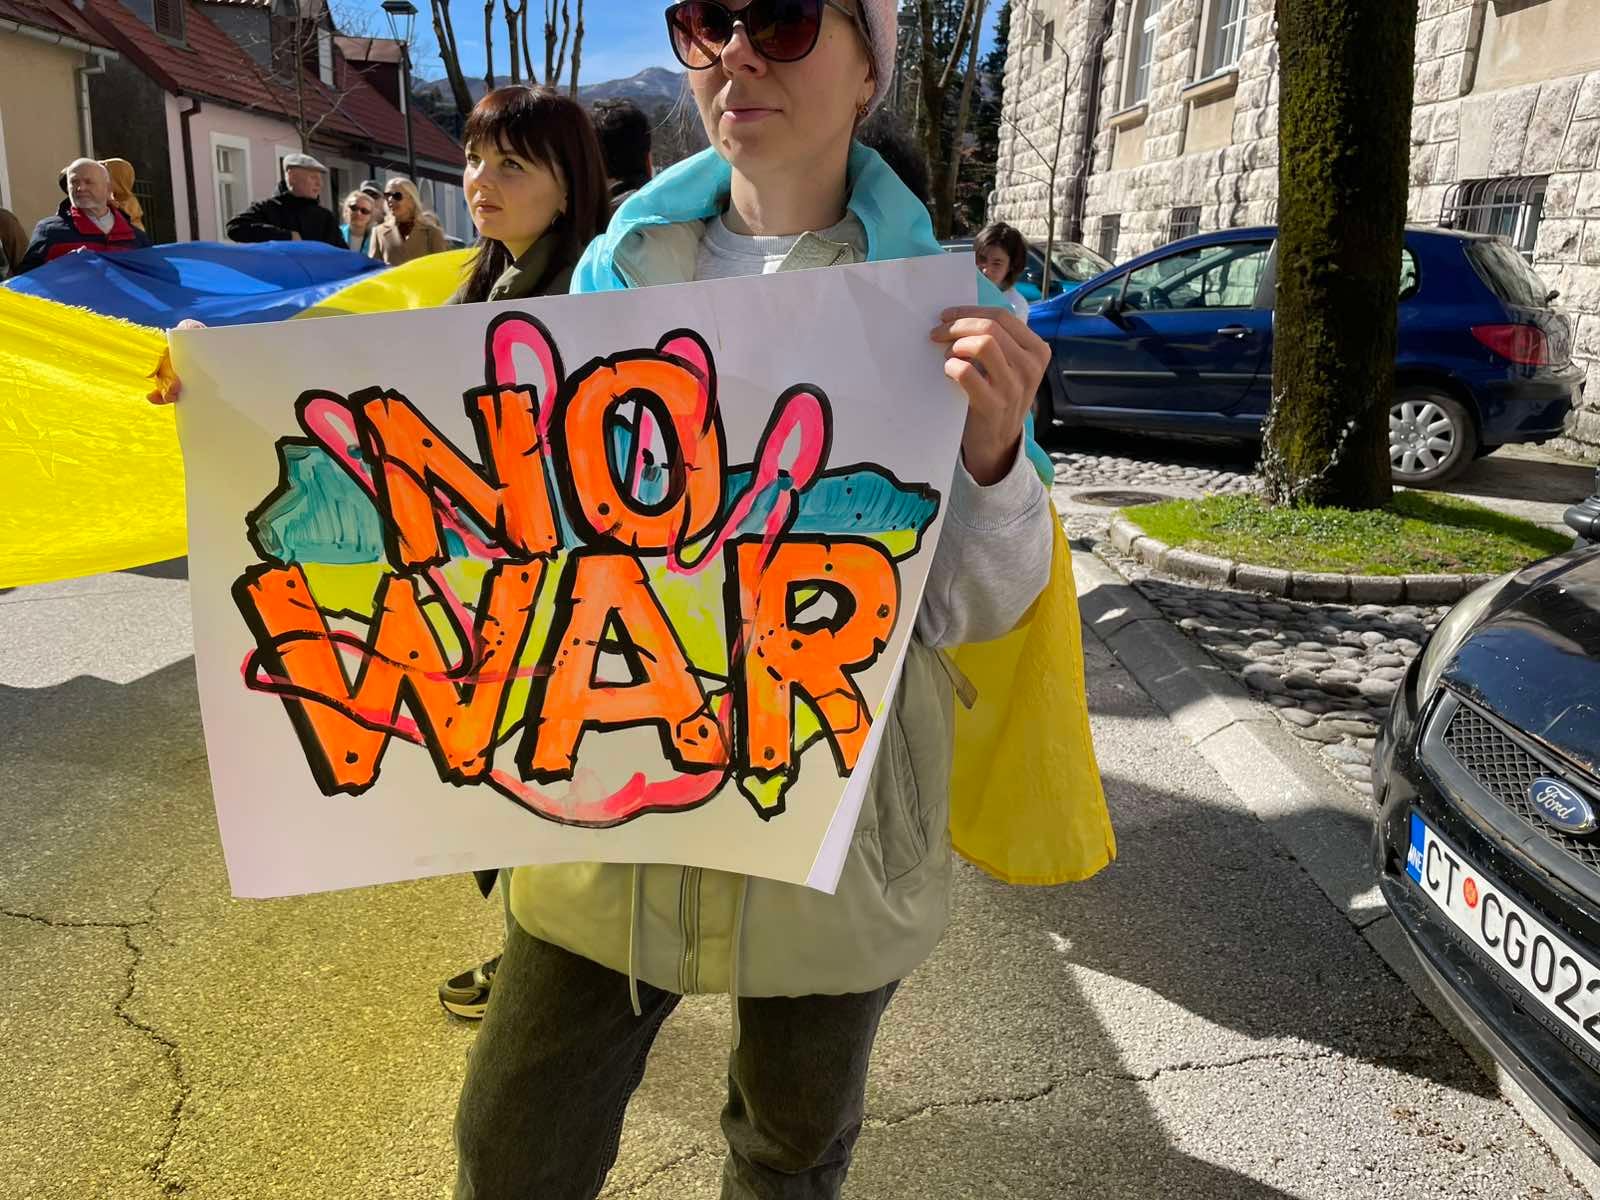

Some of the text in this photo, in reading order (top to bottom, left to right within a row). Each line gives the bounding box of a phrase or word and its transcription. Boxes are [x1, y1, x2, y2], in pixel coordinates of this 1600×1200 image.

[348, 348, 727, 567] NO
[232, 536, 902, 796] WAR
[1426, 840, 1461, 907] CT
[1536, 785, 1576, 819] Ford
